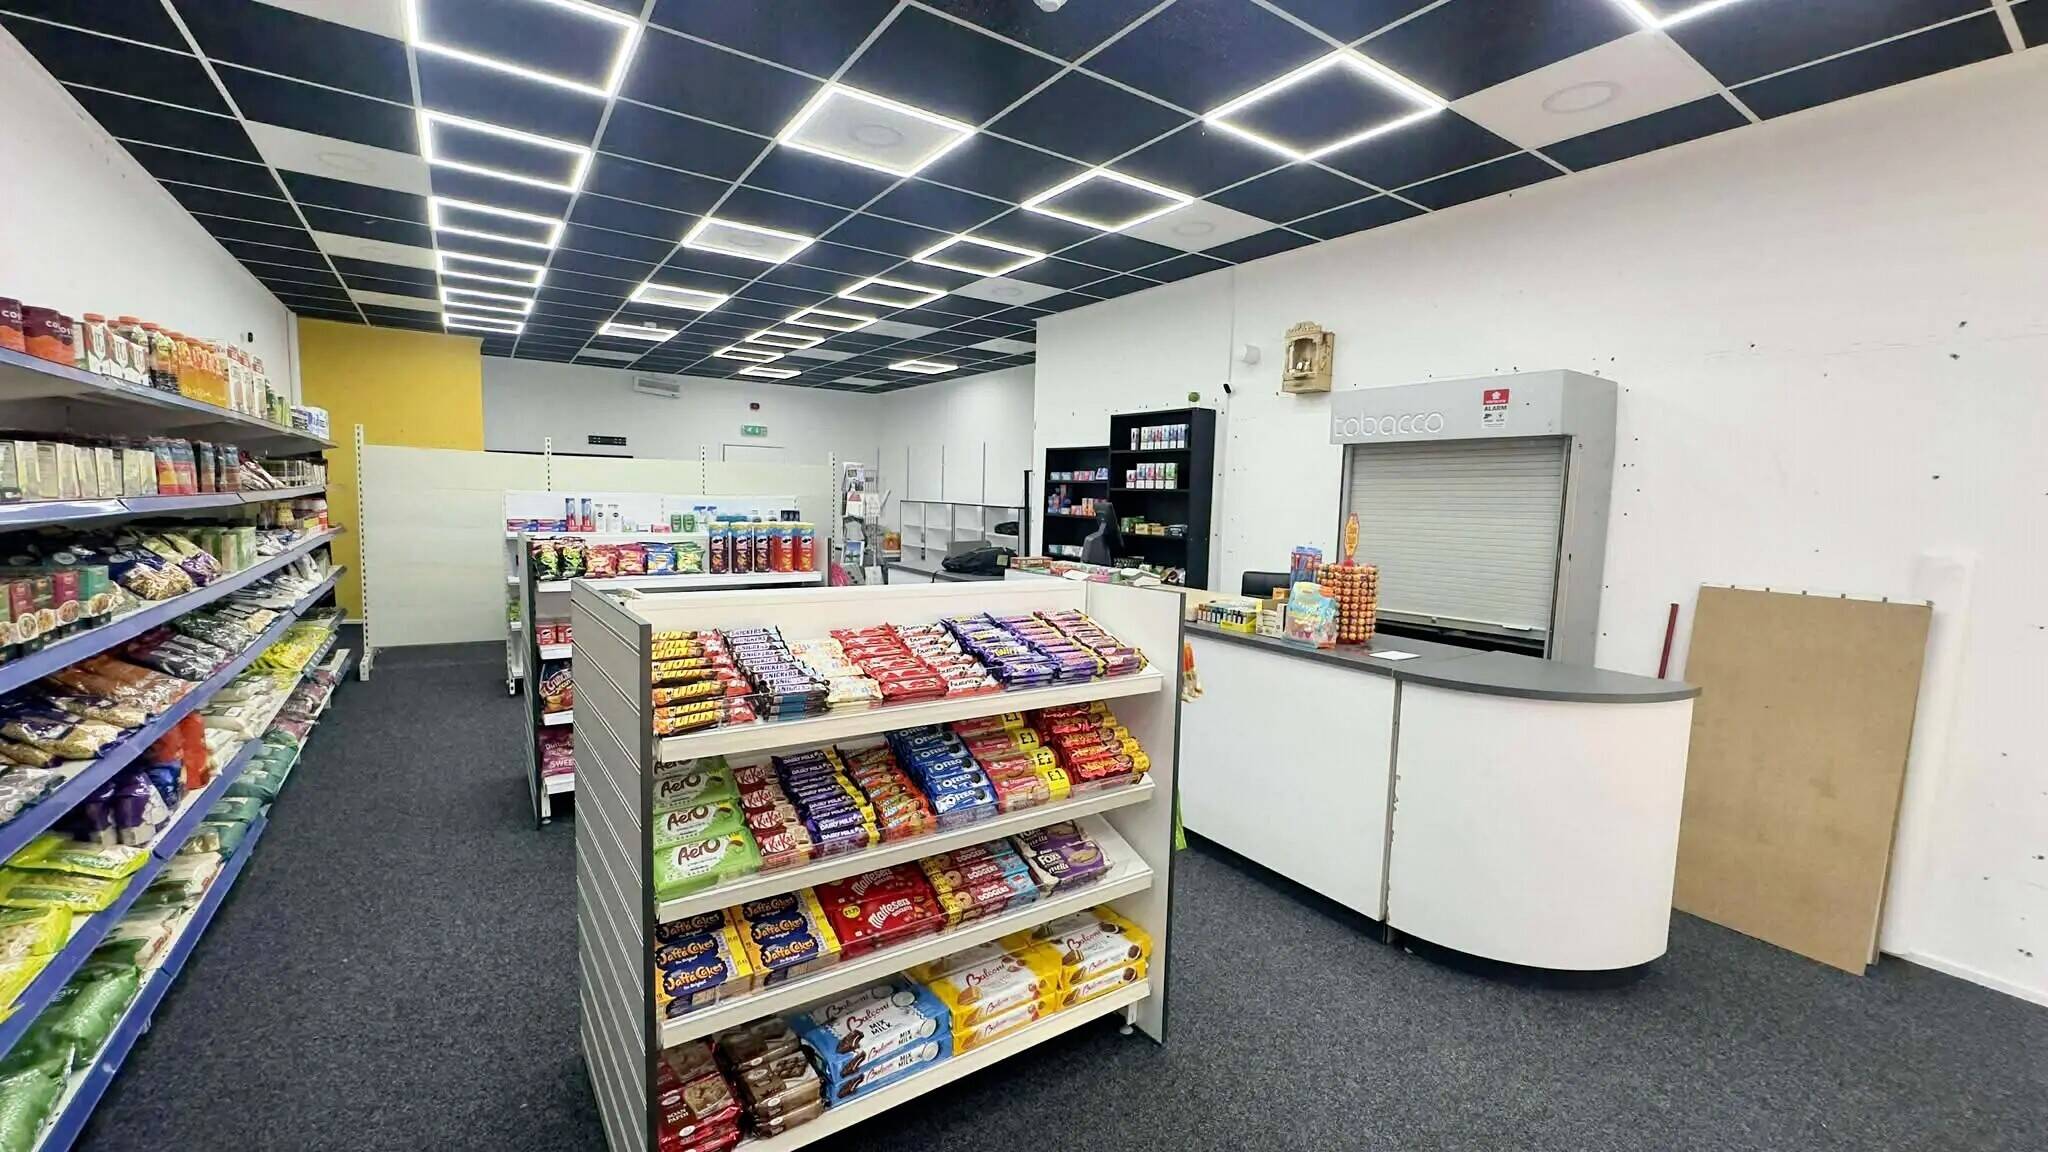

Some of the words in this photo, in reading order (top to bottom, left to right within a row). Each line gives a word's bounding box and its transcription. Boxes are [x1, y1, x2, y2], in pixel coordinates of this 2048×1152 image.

[1334, 411, 1444, 437] tobacco
[764, 670, 797, 680] SNICKERS
[1020, 732, 1035, 745] £1
[934, 758, 963, 771] OREO
[660, 773, 701, 798] Aero
[942, 773, 971, 789] OREO
[1048, 769, 1065, 782] £1
[746, 789, 774, 807] KitKat
[943, 788, 976, 806] OREO
[667, 804, 709, 831] Aero
[756, 809, 783, 829] KitKat
[820, 820, 840, 831] DAIRY
[840, 817, 855, 825] MILK
[766, 832, 795, 853] KitKat
[821, 831, 841, 840] DAIRY
[841, 828, 857, 836] MILK
[677, 838, 721, 866] Aero
[977, 886, 1010, 901] DODGERS
[868, 898, 911, 928] Maltesers
[754, 924, 781, 940] Jaffa
[779, 918, 804, 931] Cakes
[659, 948, 689, 965] Jaffa
[687, 940, 715, 955] Cakes
[762, 946, 791, 963] Jaffa
[789, 939, 815, 953] Cakes
[665, 972, 696, 990] Jaffa
[695, 963, 724, 979] Cakes
[966, 962, 1005, 987] Balconi
[846, 1001, 890, 1032] Balconi
[868, 1019, 888, 1029] MIX
[871, 1022, 892, 1035] MILK
